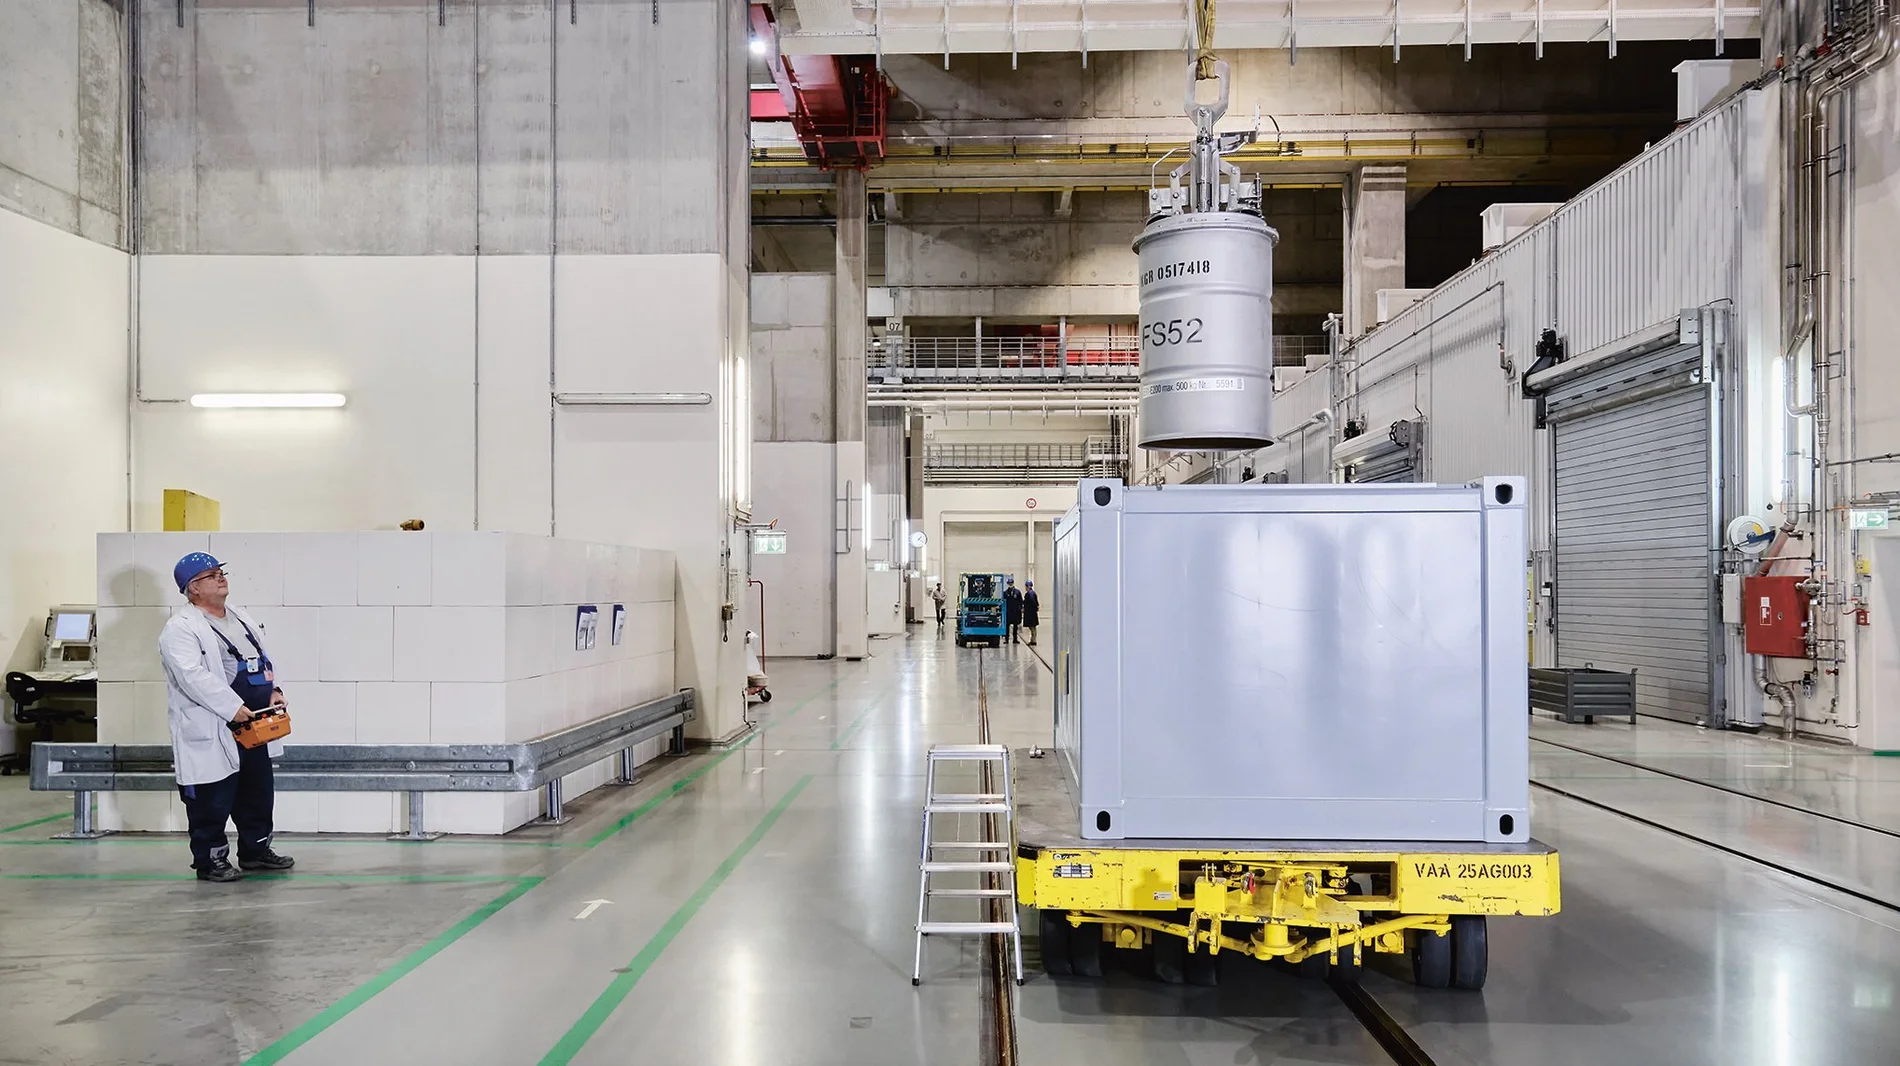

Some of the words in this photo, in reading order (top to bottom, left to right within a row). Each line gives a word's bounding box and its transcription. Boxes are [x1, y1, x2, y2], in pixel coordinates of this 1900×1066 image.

[1157, 260, 1210, 280] 0517418
[889, 322, 900, 331] 07
[1142, 318, 1203, 350] FS52
[1175, 381, 1188, 391] 500
[1415, 863, 1451, 879] VAA
[1458, 863, 1533, 879] 25AG003
